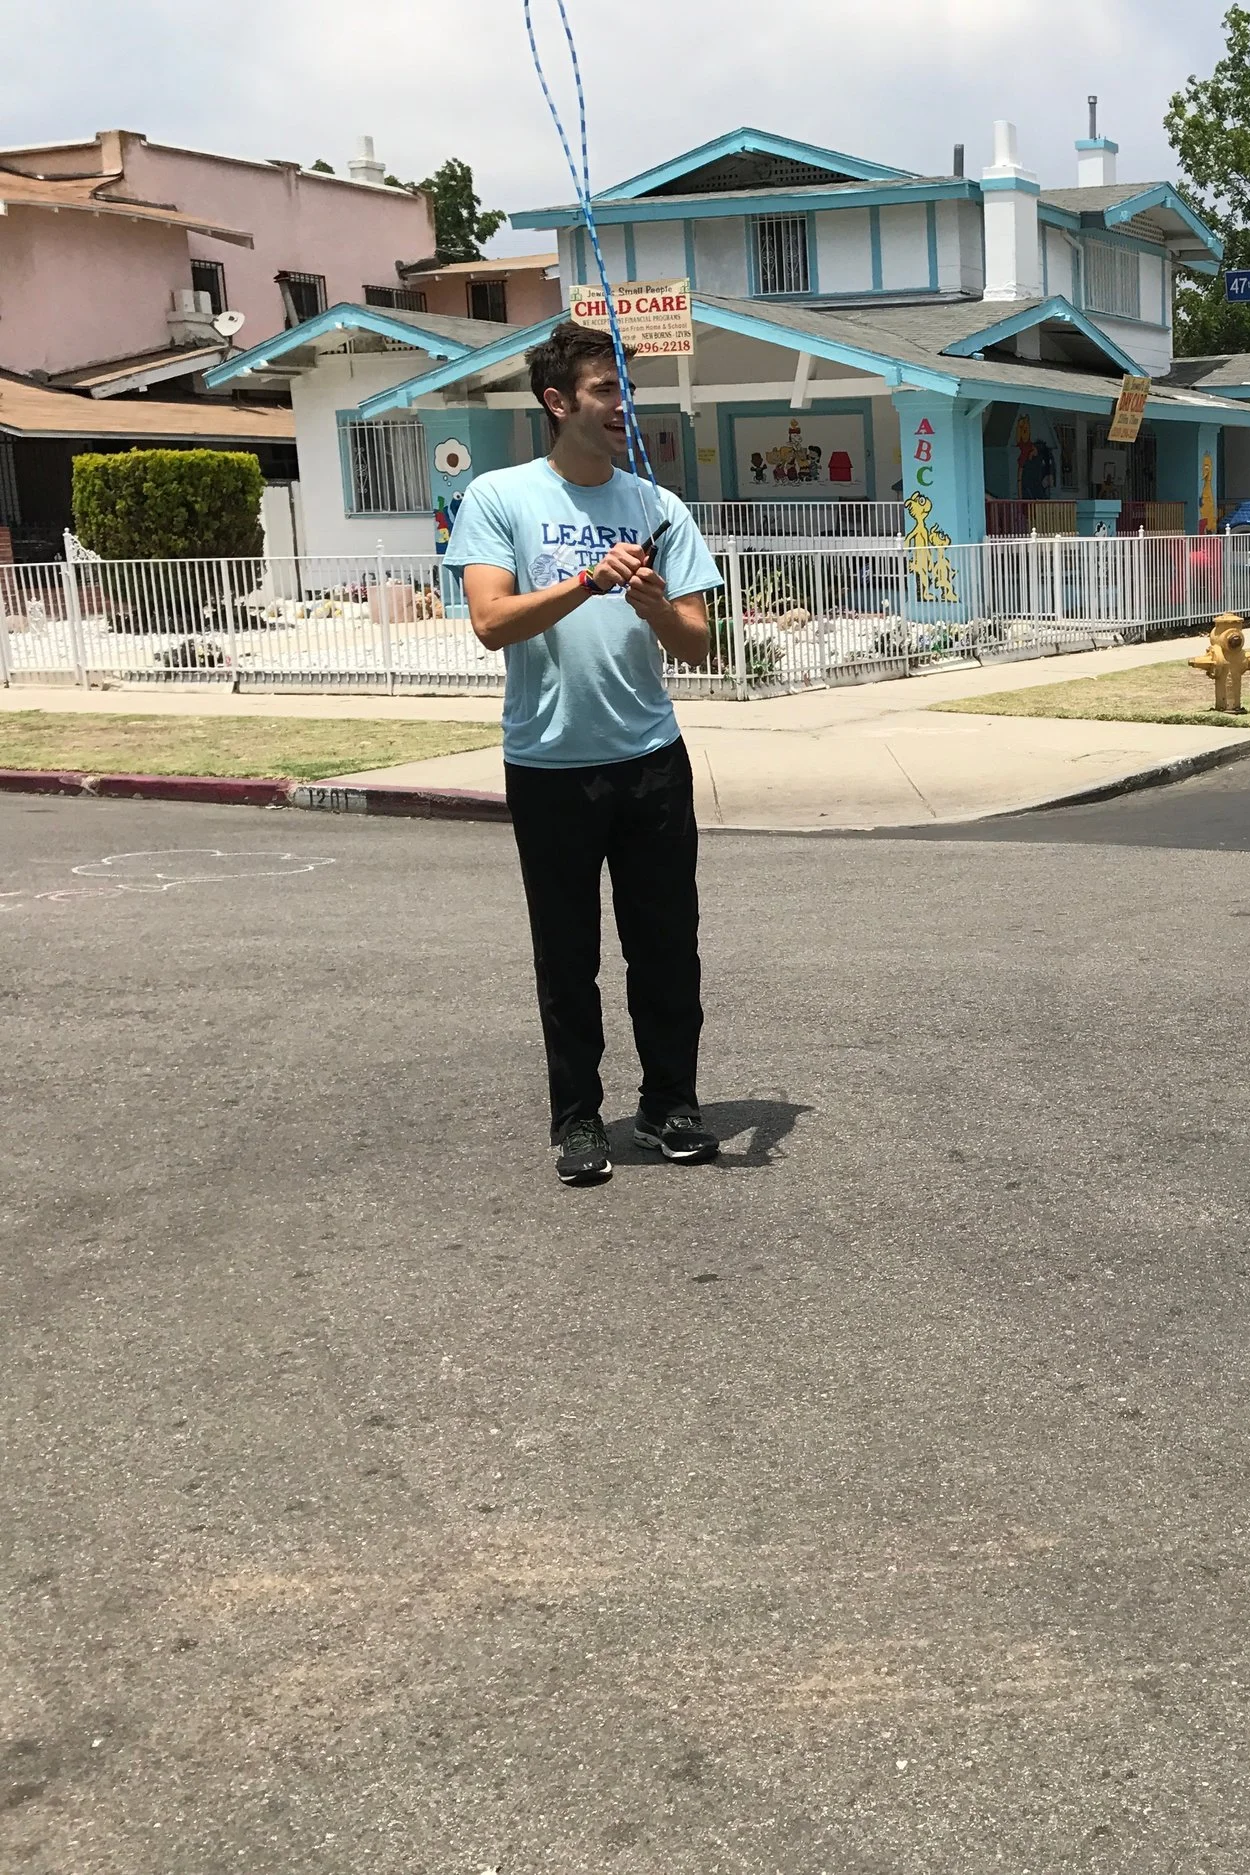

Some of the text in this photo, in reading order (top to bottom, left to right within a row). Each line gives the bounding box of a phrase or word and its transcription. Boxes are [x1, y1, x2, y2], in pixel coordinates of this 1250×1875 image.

[618, 287, 643, 296] Small
[645, 286, 672, 295] People
[574, 295, 687, 317] CHID CARE
[636, 340, 691, 353] 296-2218
[541, 523, 638, 549] LEARN
